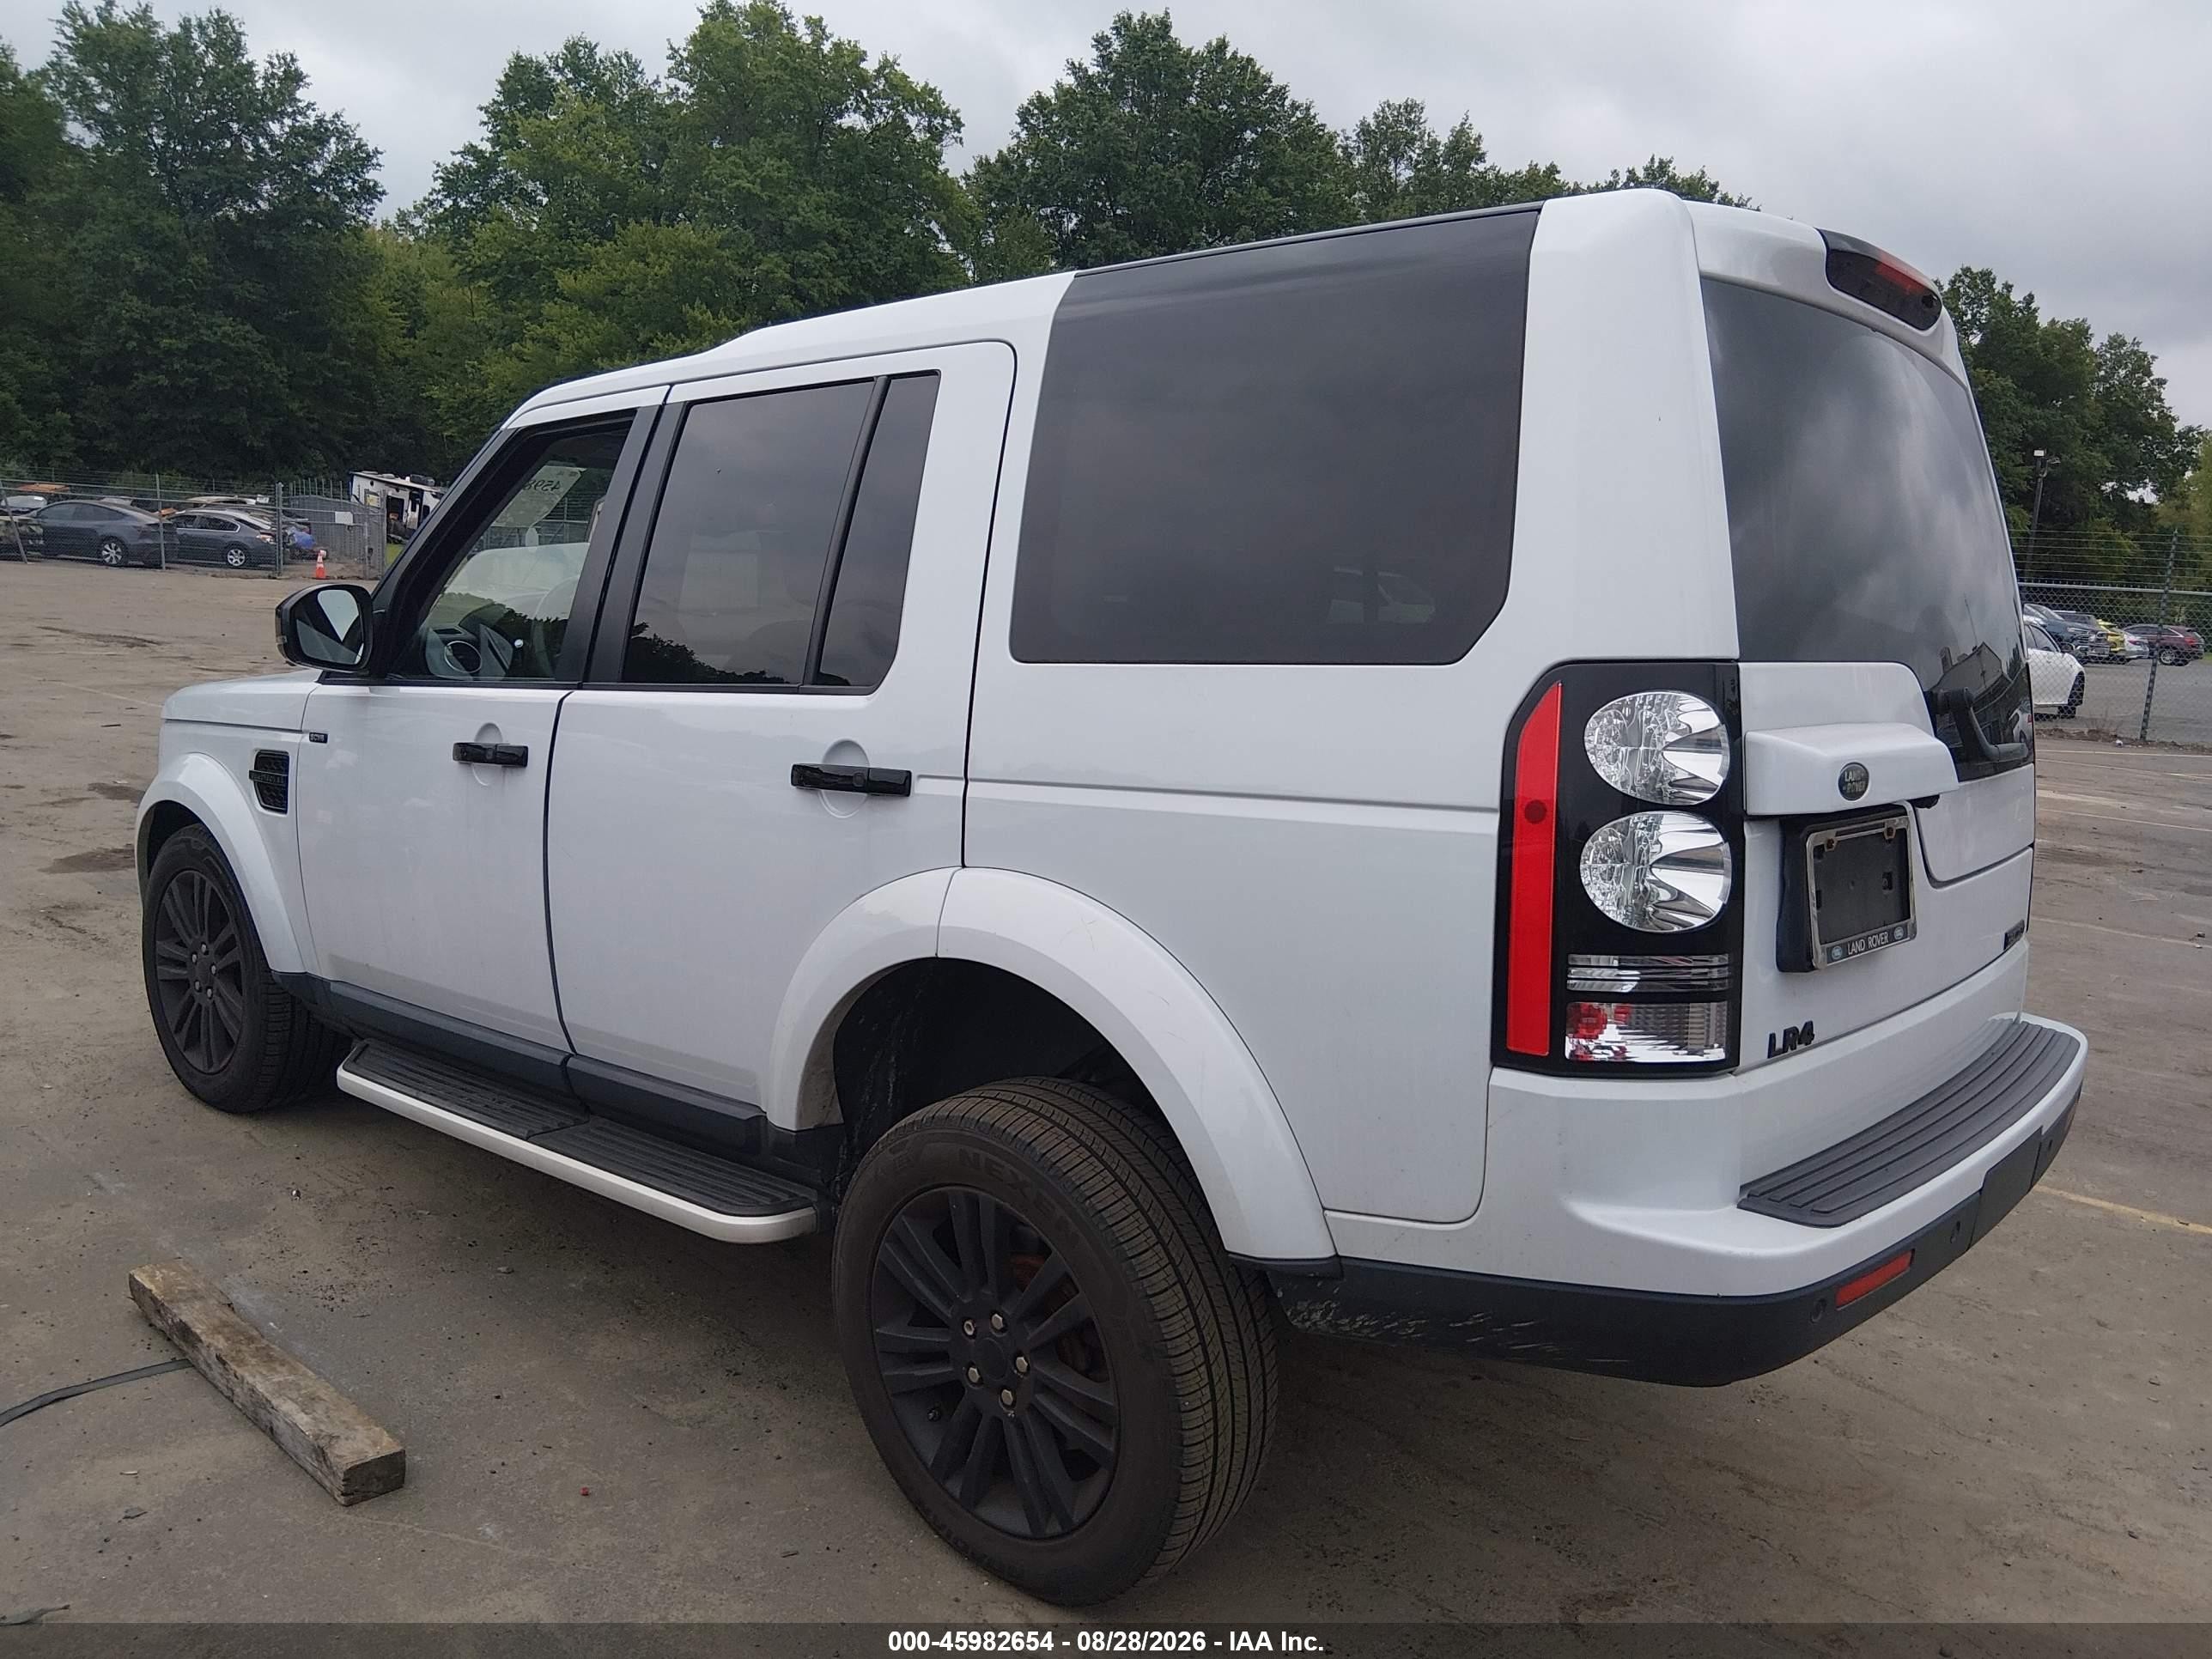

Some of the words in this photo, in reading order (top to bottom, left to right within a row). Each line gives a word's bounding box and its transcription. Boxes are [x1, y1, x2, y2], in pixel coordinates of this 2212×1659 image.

[1847, 939, 1866, 956] LAND
[1868, 931, 1889, 950] ROVER
[1767, 1020, 1815, 1059] LR4
